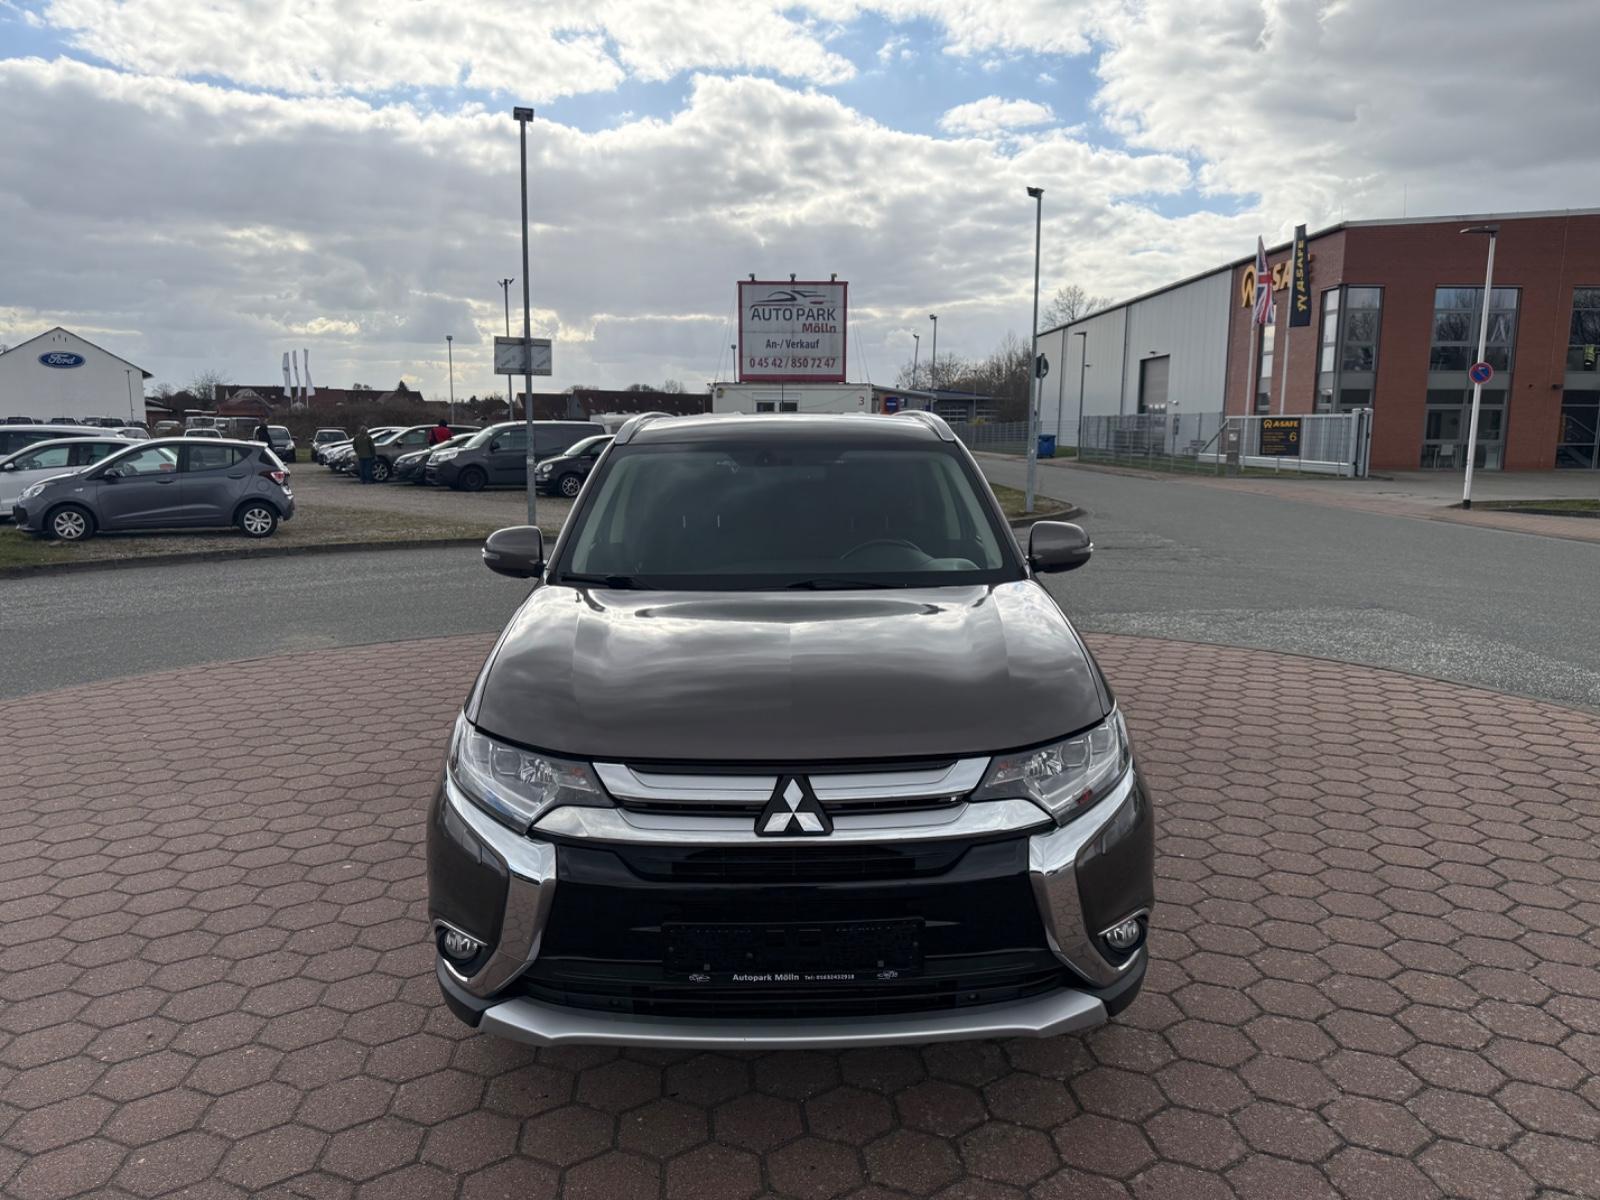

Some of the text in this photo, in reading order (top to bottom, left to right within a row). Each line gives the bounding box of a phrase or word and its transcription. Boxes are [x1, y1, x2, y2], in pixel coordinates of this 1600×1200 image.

[751, 307, 836, 321] AUTO PARK
[802, 322, 837, 333] Mölln
[785, 338, 820, 349] Verkauf
[749, 358, 755, 368] 0
[757, 358, 769, 368] 45
[771, 358, 783, 368] 42
[791, 358, 808, 368] 850
[811, 358, 822, 368] 72
[824, 358, 837, 368] 47
[858, 396, 865, 406] 3
[1289, 431, 1297, 442] 6
[733, 973, 772, 982] Autopark
[775, 972, 800, 981] Mölln
